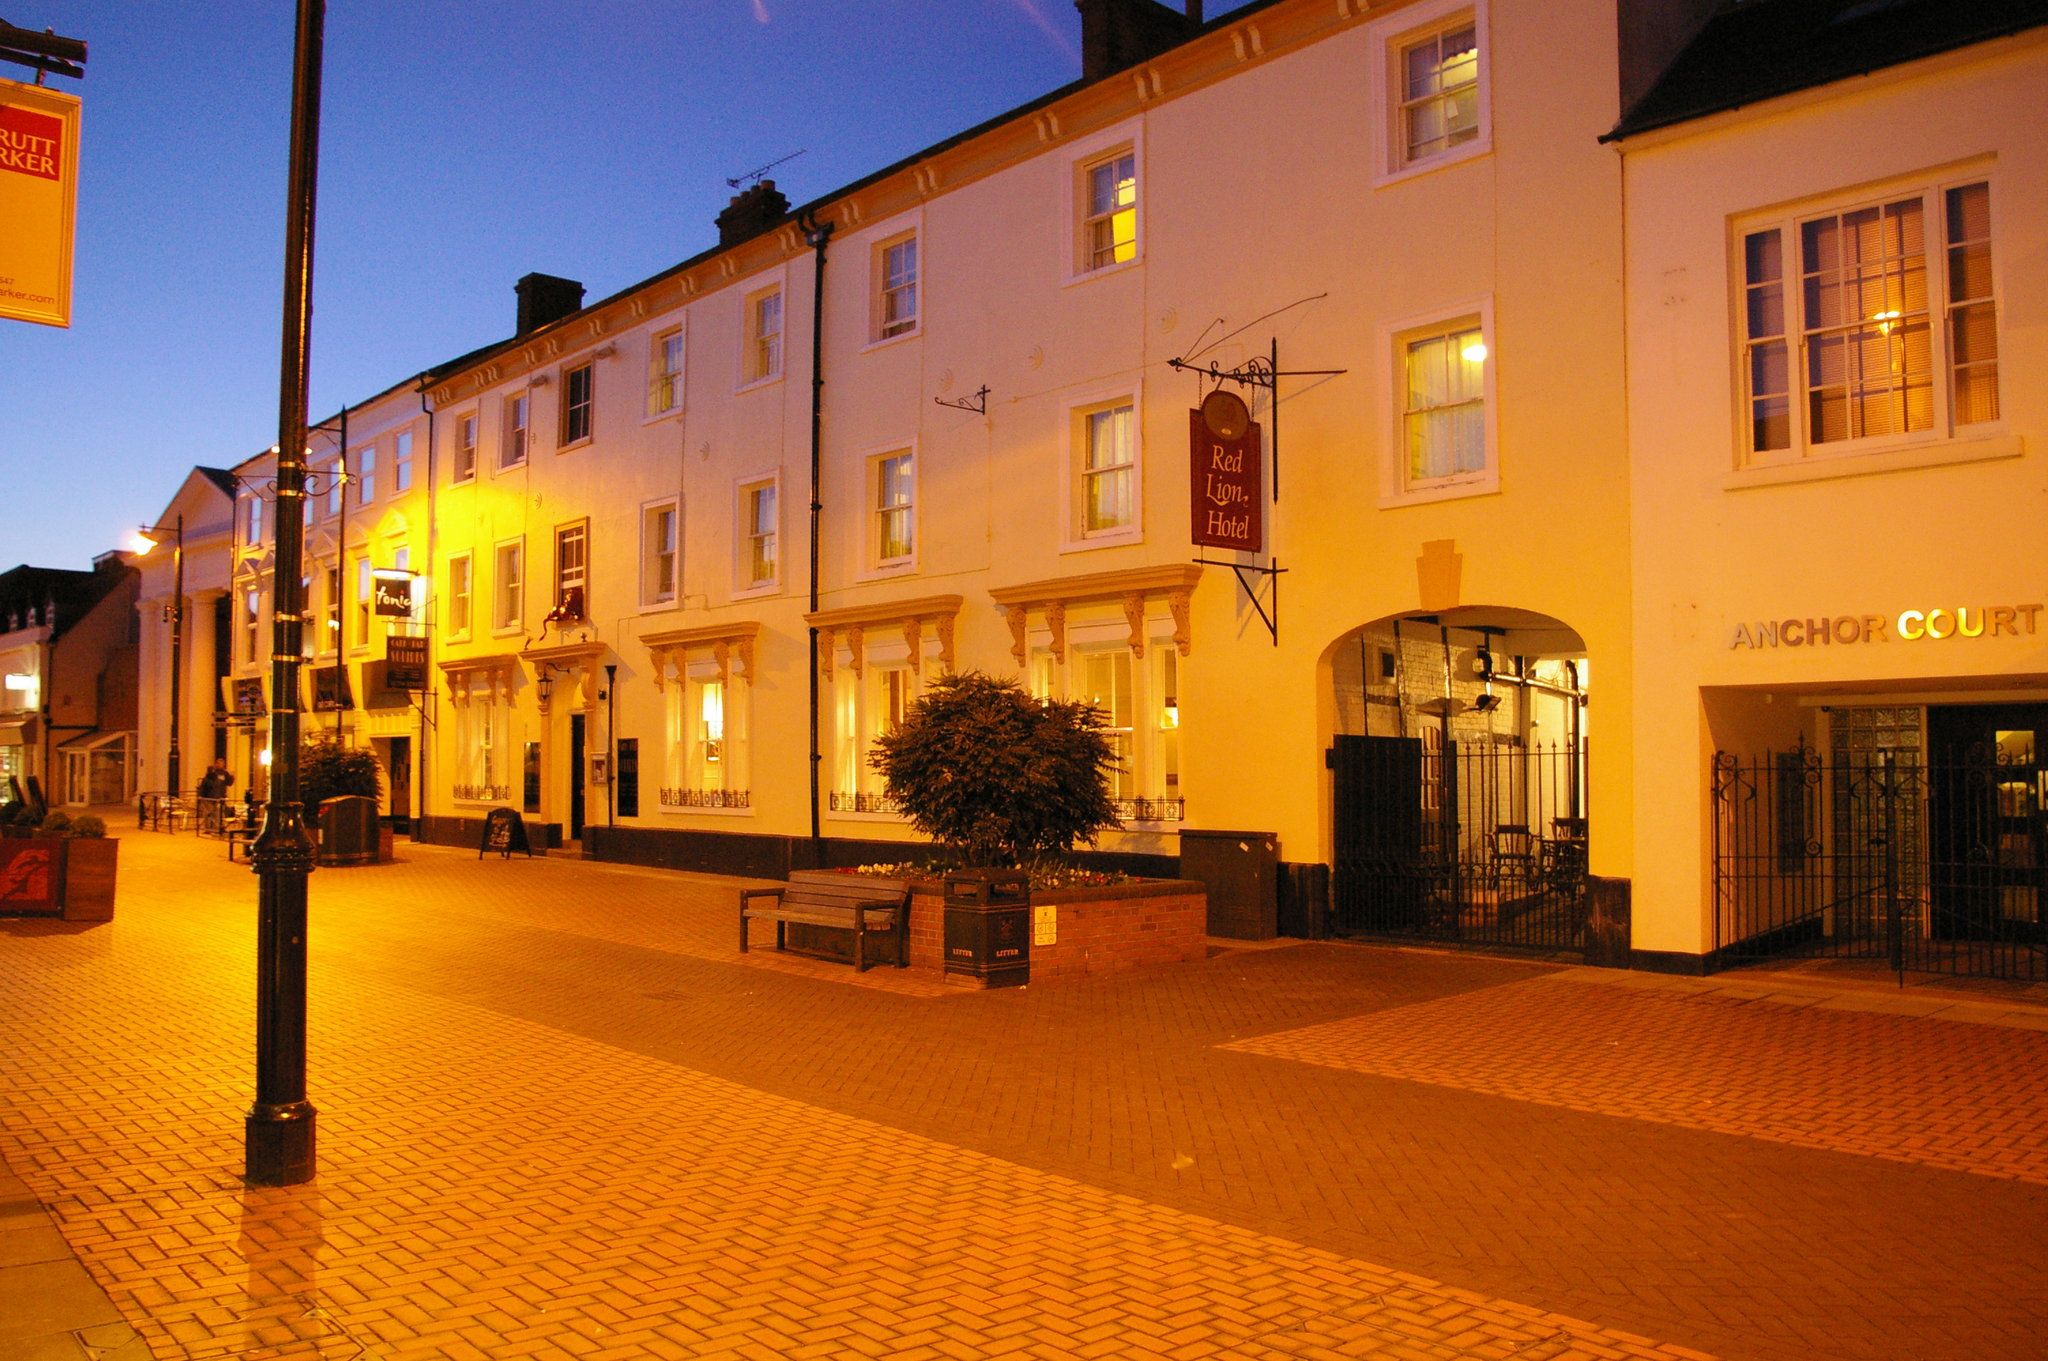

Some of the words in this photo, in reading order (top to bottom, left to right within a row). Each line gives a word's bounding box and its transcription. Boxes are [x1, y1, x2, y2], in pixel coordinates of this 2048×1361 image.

[1211, 444, 1243, 473] Red
[1206, 473, 1249, 507] Lion
[1206, 510, 1249, 539] Hotel
[376, 585, 412, 609] tonic
[1729, 614, 1888, 649] ANCHOR
[1897, 603, 2044, 640] COURT
[996, 948, 1019, 957] LITTER
